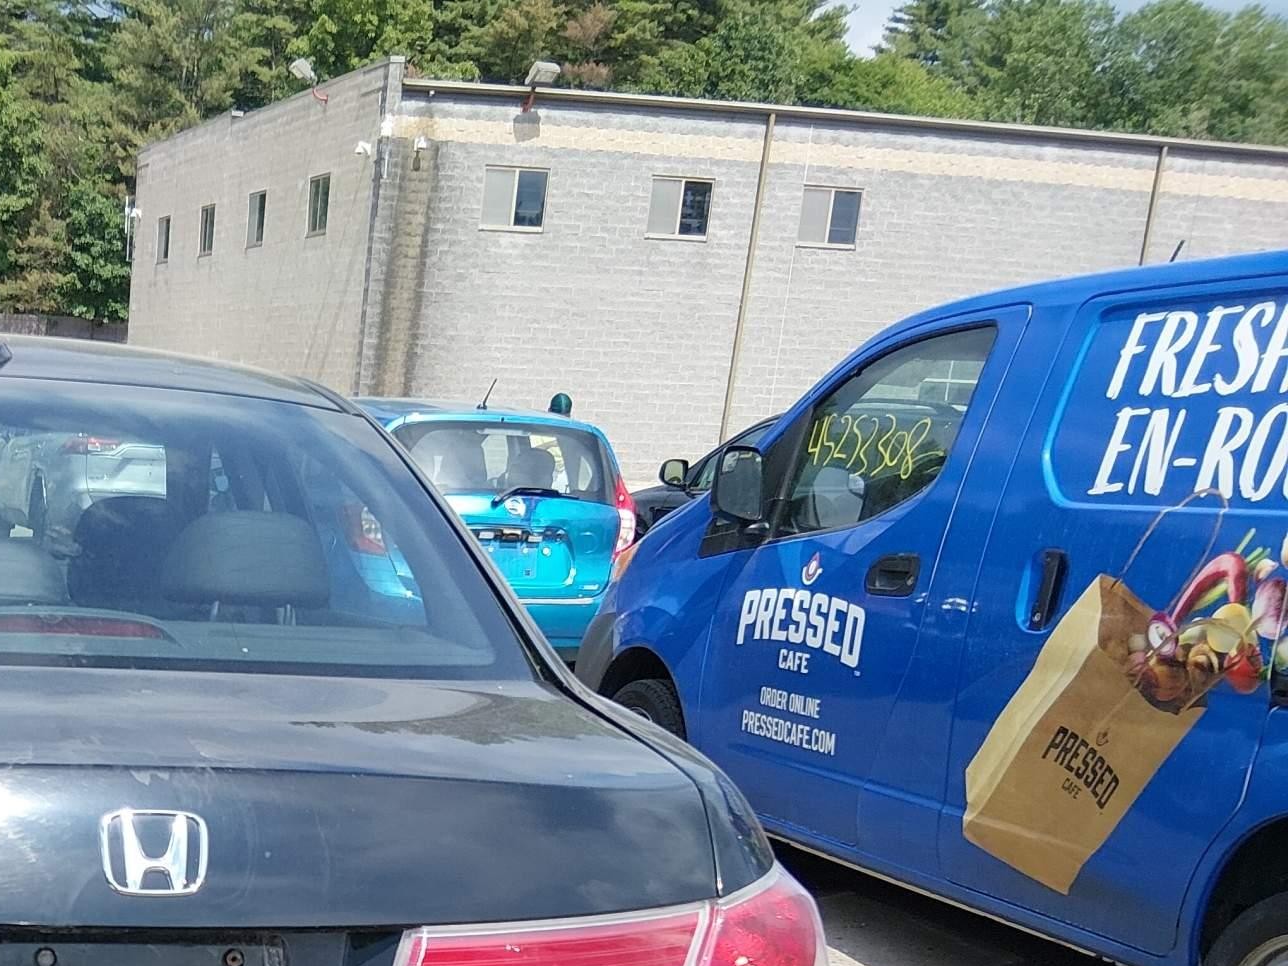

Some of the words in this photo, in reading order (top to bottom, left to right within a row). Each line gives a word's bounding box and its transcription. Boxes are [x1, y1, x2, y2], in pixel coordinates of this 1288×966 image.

[1087, 402, 1288, 502] EN-RO
[736, 588, 866, 668] PRESSED
[778, 649, 810, 674] CAFE
[760, 686, 787, 711] ORDER
[788, 693, 821, 719] ONLINE
[741, 710, 836, 756] PRESSEDCAFE.COM
[1041, 725, 1120, 810] PRESSED
[1061, 777, 1082, 800] CAFE
